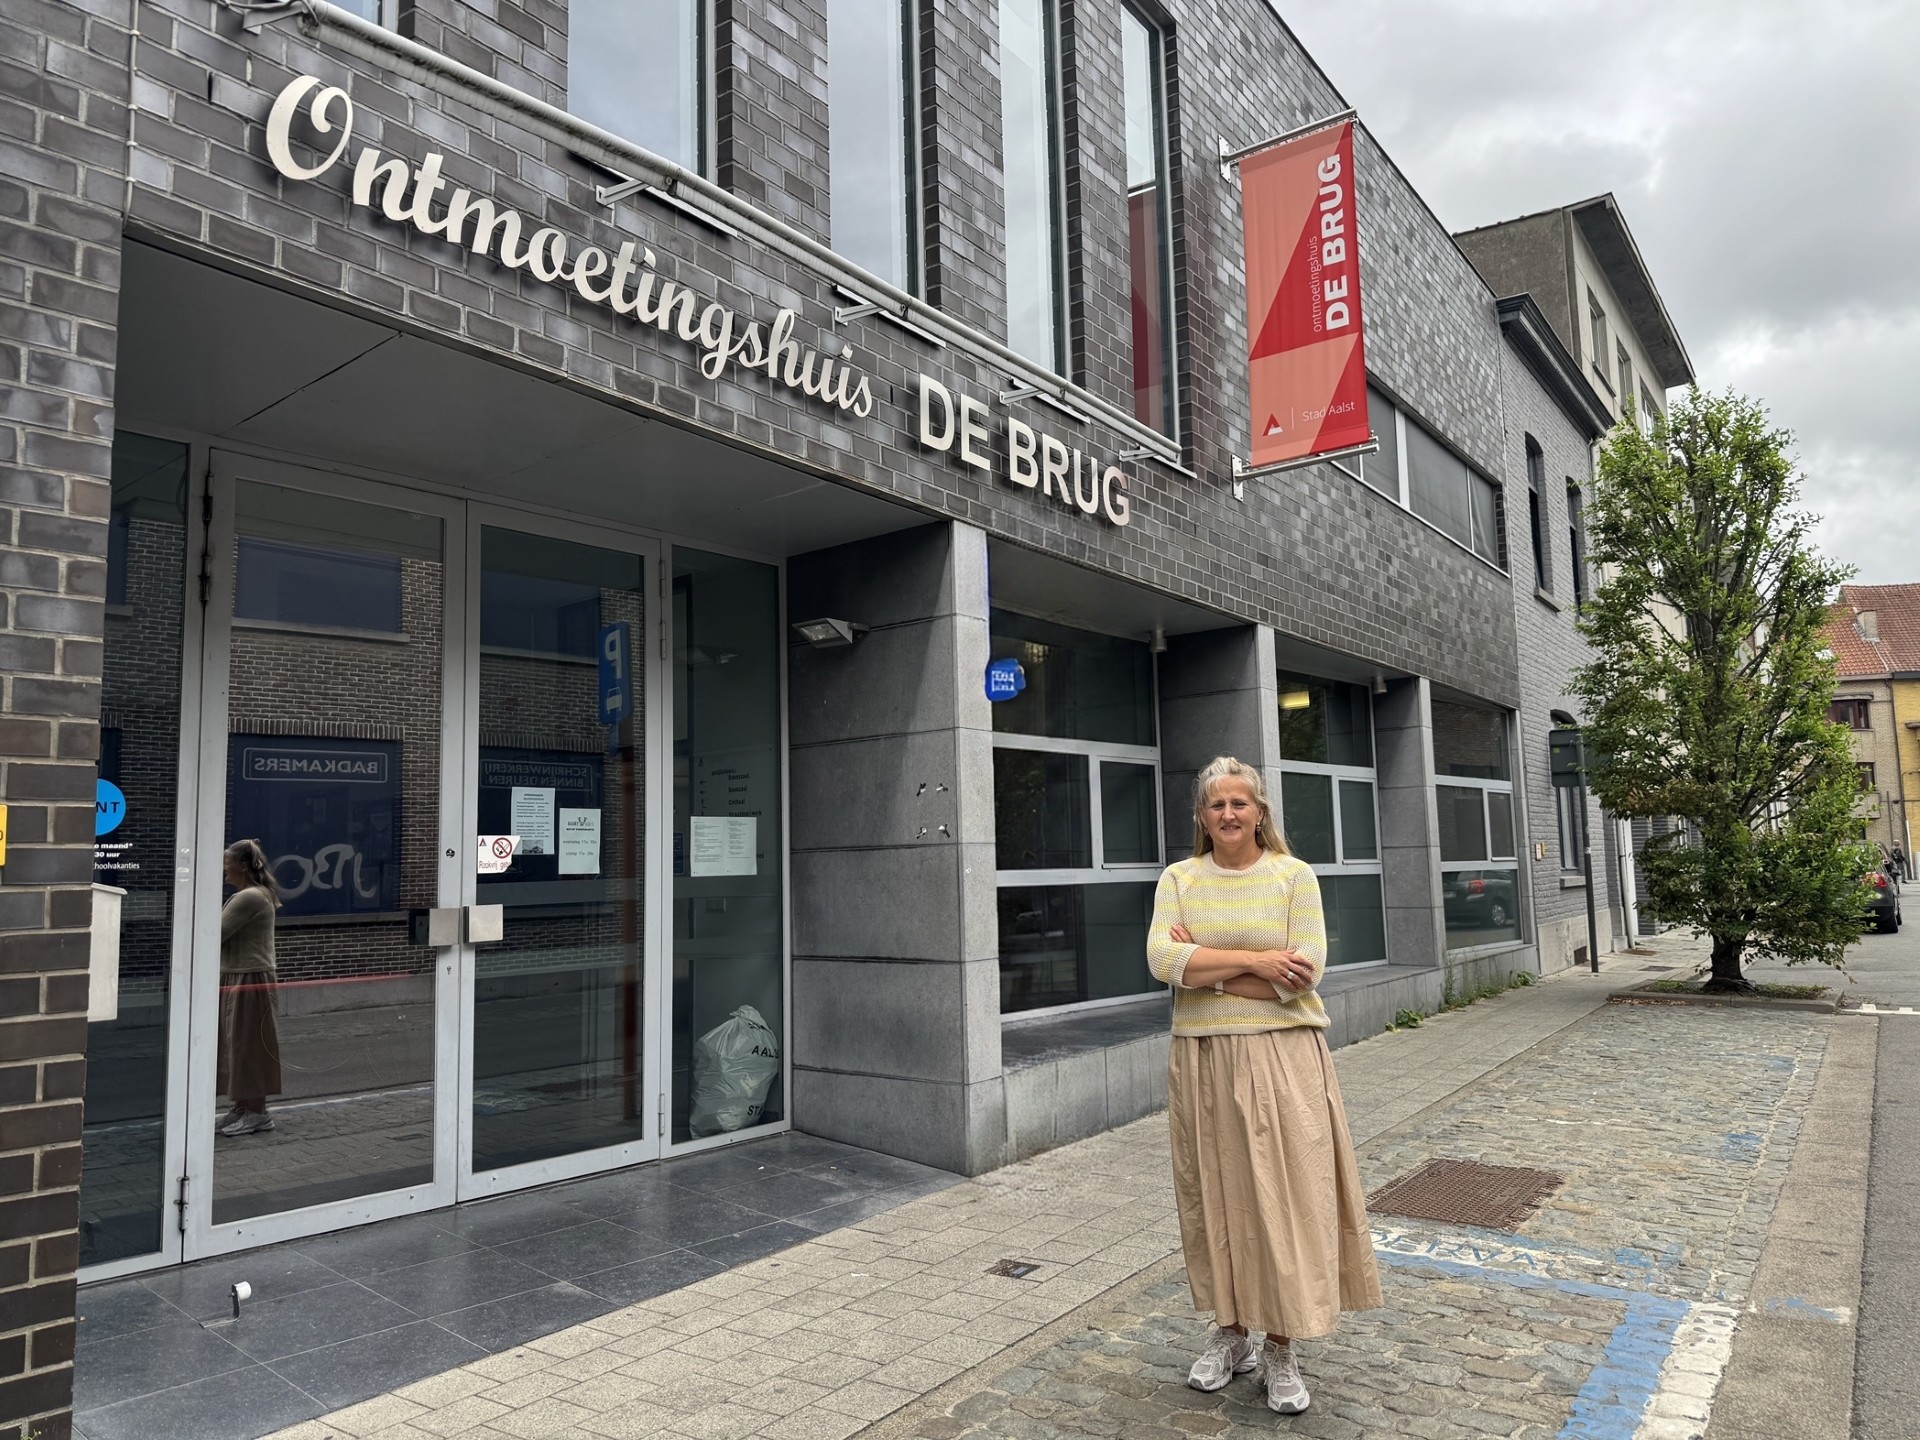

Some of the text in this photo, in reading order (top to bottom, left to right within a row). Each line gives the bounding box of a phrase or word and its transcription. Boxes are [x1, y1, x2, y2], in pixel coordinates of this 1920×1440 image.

[266, 75, 872, 418] Ontmoetingshuis
[1307, 235, 1323, 333] ontmoetingshuis
[1316, 153, 1350, 331] DE BRUG
[919, 373, 1131, 527] DE BRUG
[1302, 400, 1355, 422] Stad Aalst
